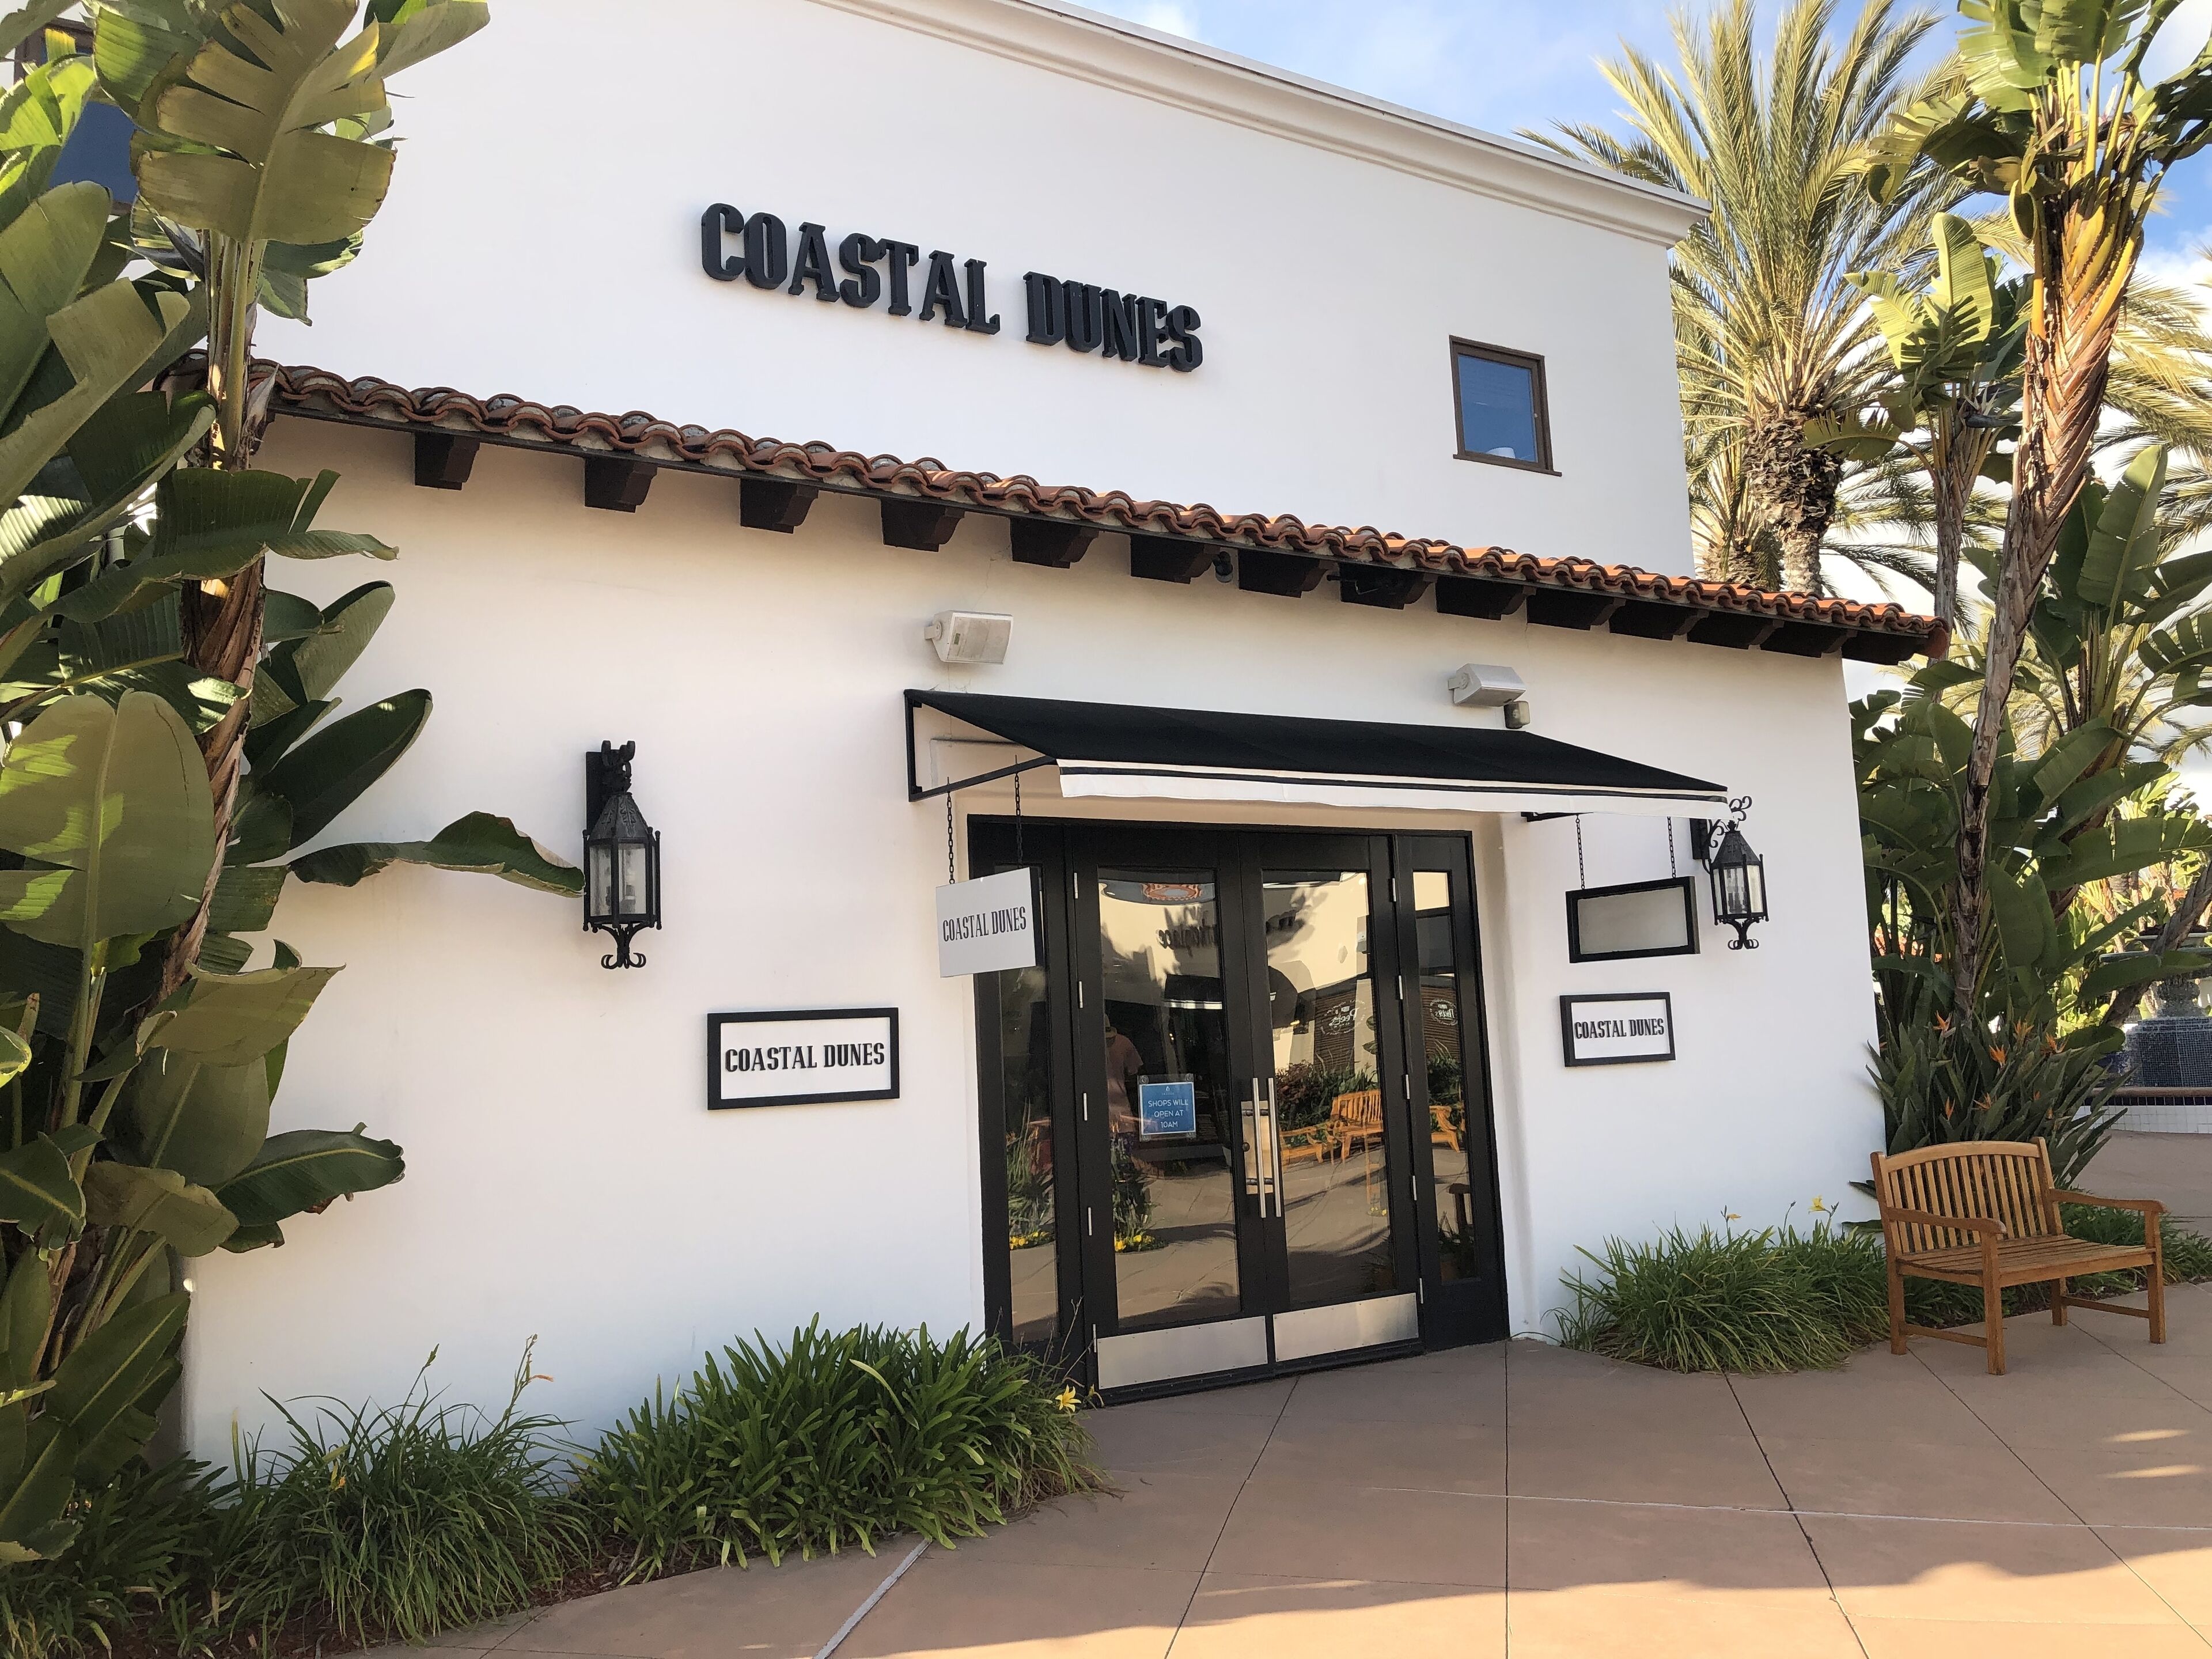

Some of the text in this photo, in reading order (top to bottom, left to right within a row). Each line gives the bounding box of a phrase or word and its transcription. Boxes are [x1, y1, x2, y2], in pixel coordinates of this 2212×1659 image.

[701, 203, 1203, 373] COASTAL DUNES
[942, 906, 1027, 942] COASTAL DUNES
[1574, 1018, 1664, 1039] COASTAL DUNES
[725, 1043, 885, 1072] COASTAL DUNES
